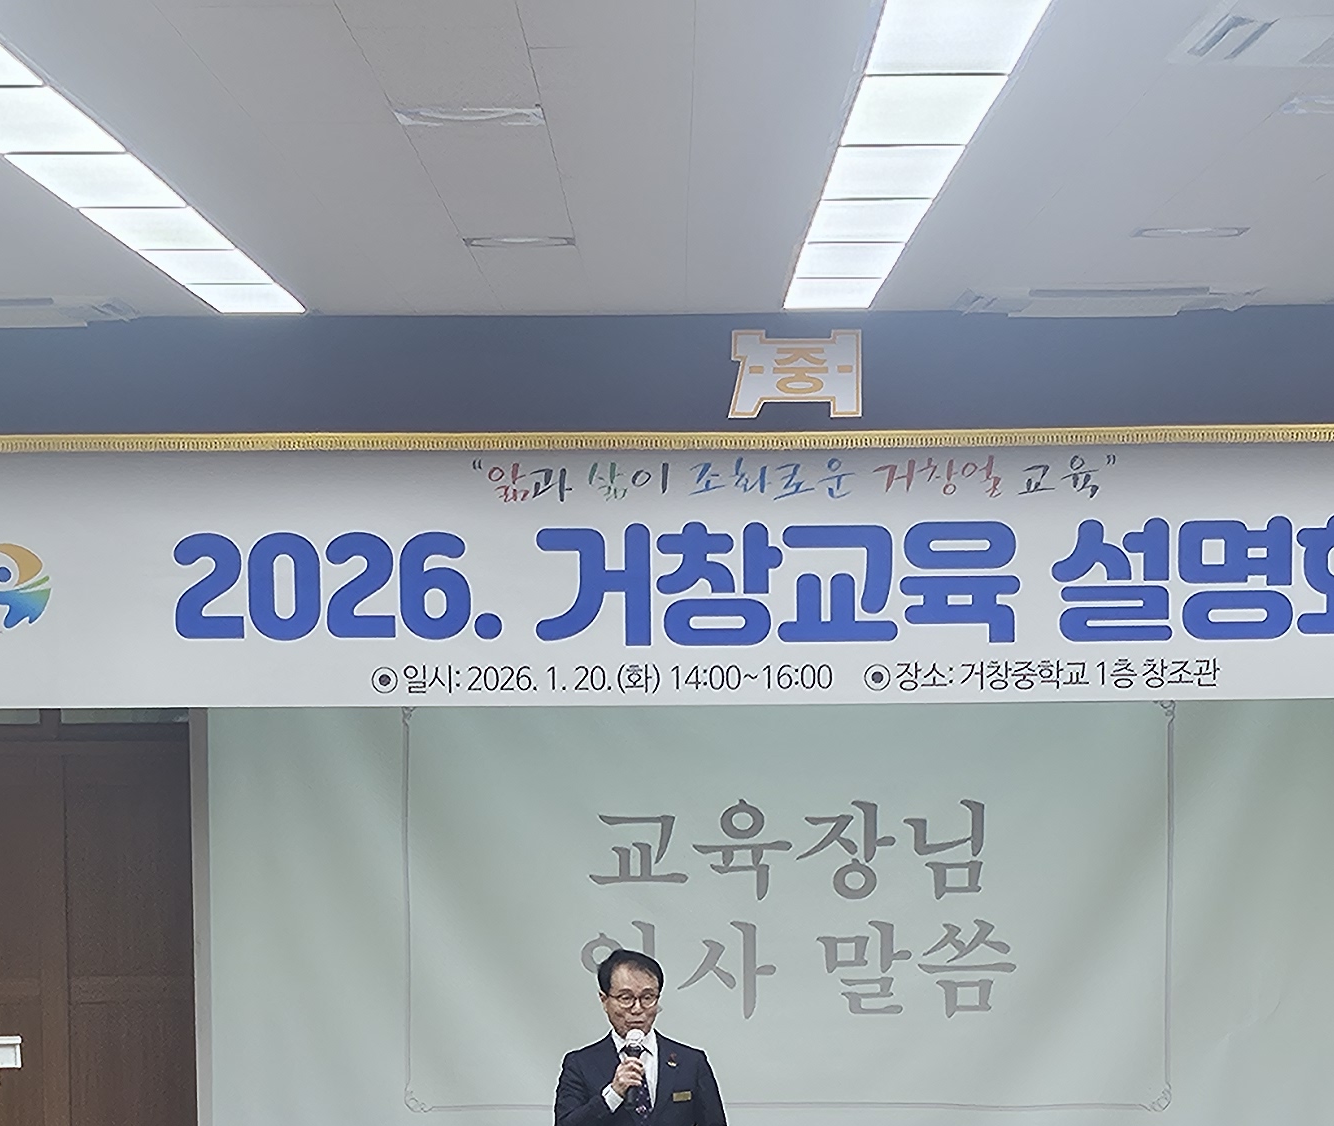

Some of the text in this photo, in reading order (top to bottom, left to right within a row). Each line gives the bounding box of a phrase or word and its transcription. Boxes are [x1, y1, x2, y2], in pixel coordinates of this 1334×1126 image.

[772, 346, 829, 395] 중
[588, 461, 670, 501] 삶이
[688, 456, 856, 501] 조화로운
[172, 531, 503, 641] 2026.
[534, 520, 1021, 647] 거창교육
[403, 664, 461, 694] 일시:
[467, 665, 538, 692] 2026.
[546, 666, 567, 691] 1.
[670, 663, 833, 691] 14:00~16:00
[896, 657, 1221, 692] 장소: 거창중학교 1층 창조관
[588, 798, 988, 901] 교육장님
[816, 918, 1017, 1020] 말씀
